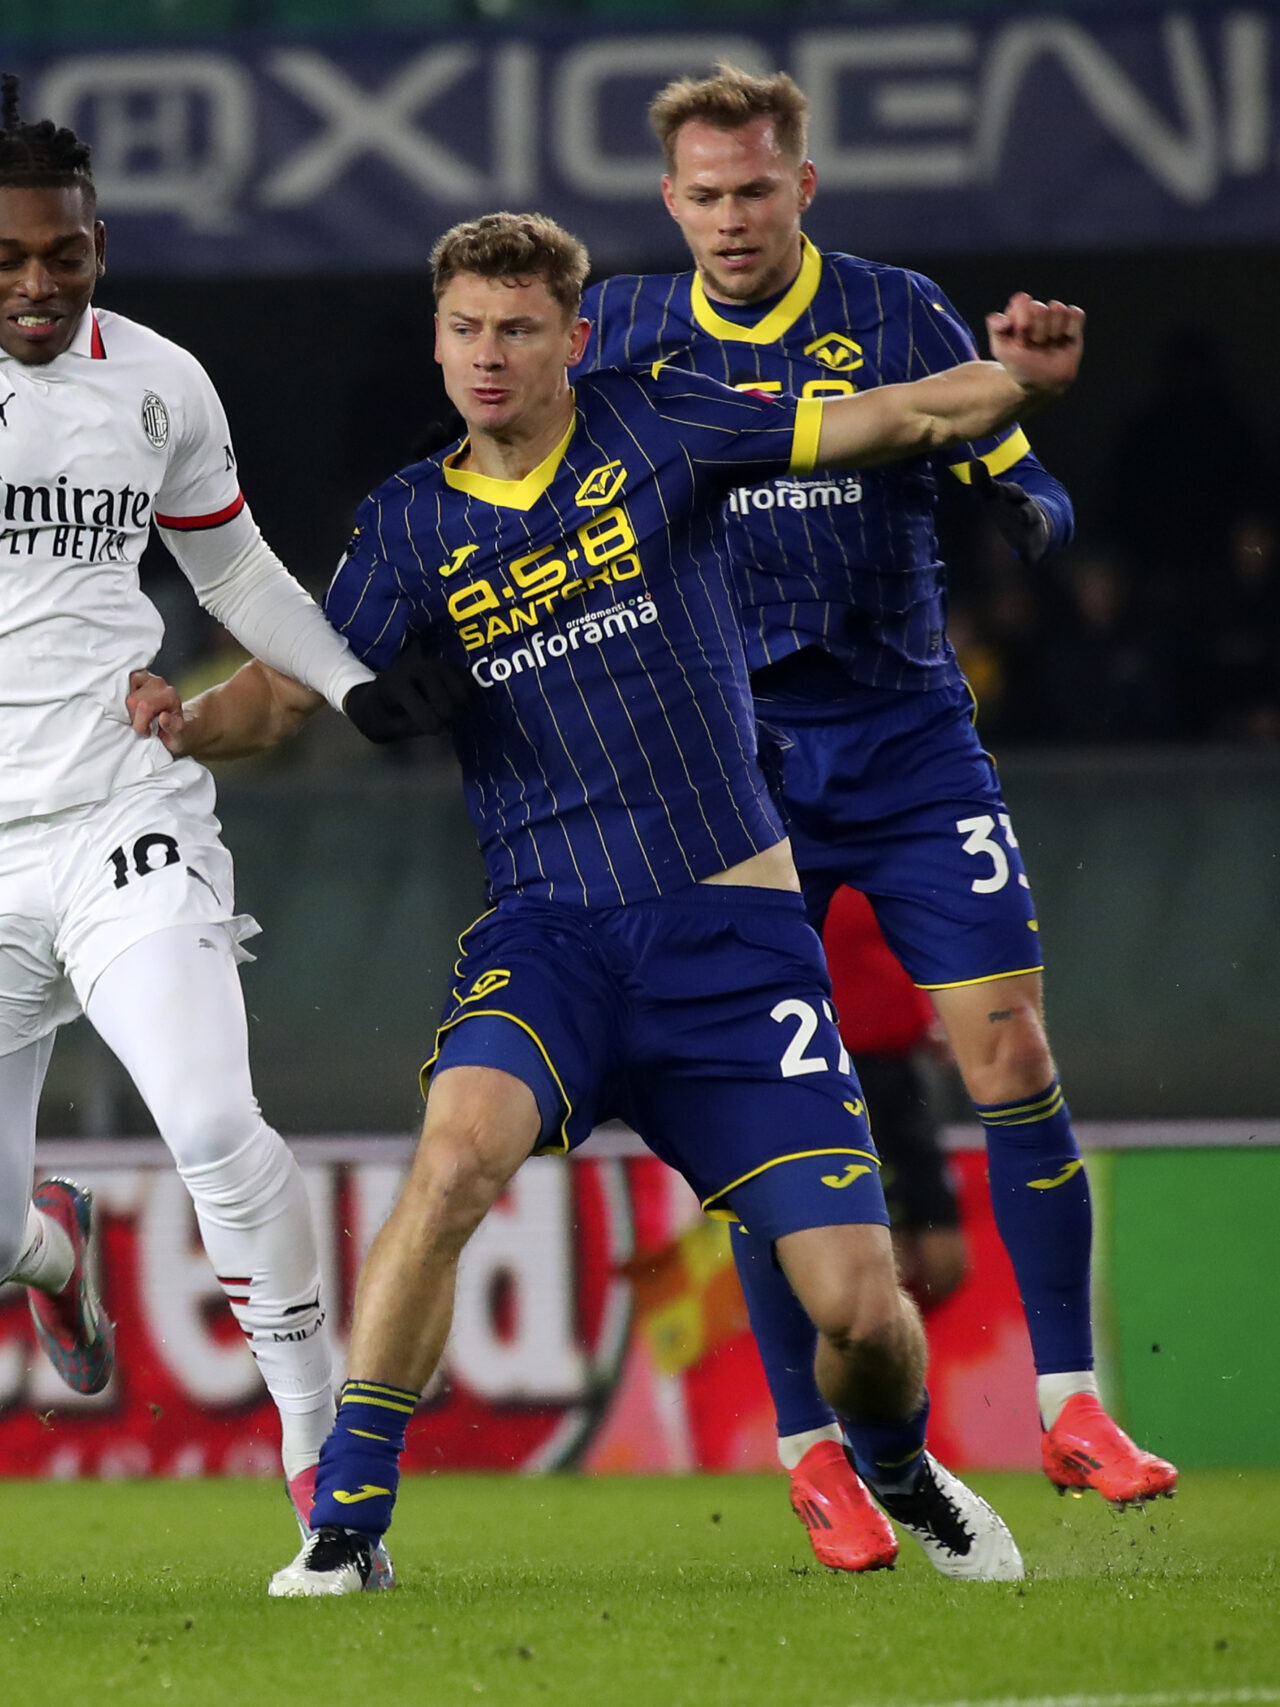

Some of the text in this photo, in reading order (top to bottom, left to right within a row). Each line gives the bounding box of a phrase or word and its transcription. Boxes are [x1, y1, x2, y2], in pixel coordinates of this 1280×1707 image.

[730, 481, 863, 515] forama
[566, 601, 626, 629] arredamenti
[472, 599, 658, 688] Conforama
[104, 832, 181, 890] 10
[273, 1311, 325, 1343] MILA
